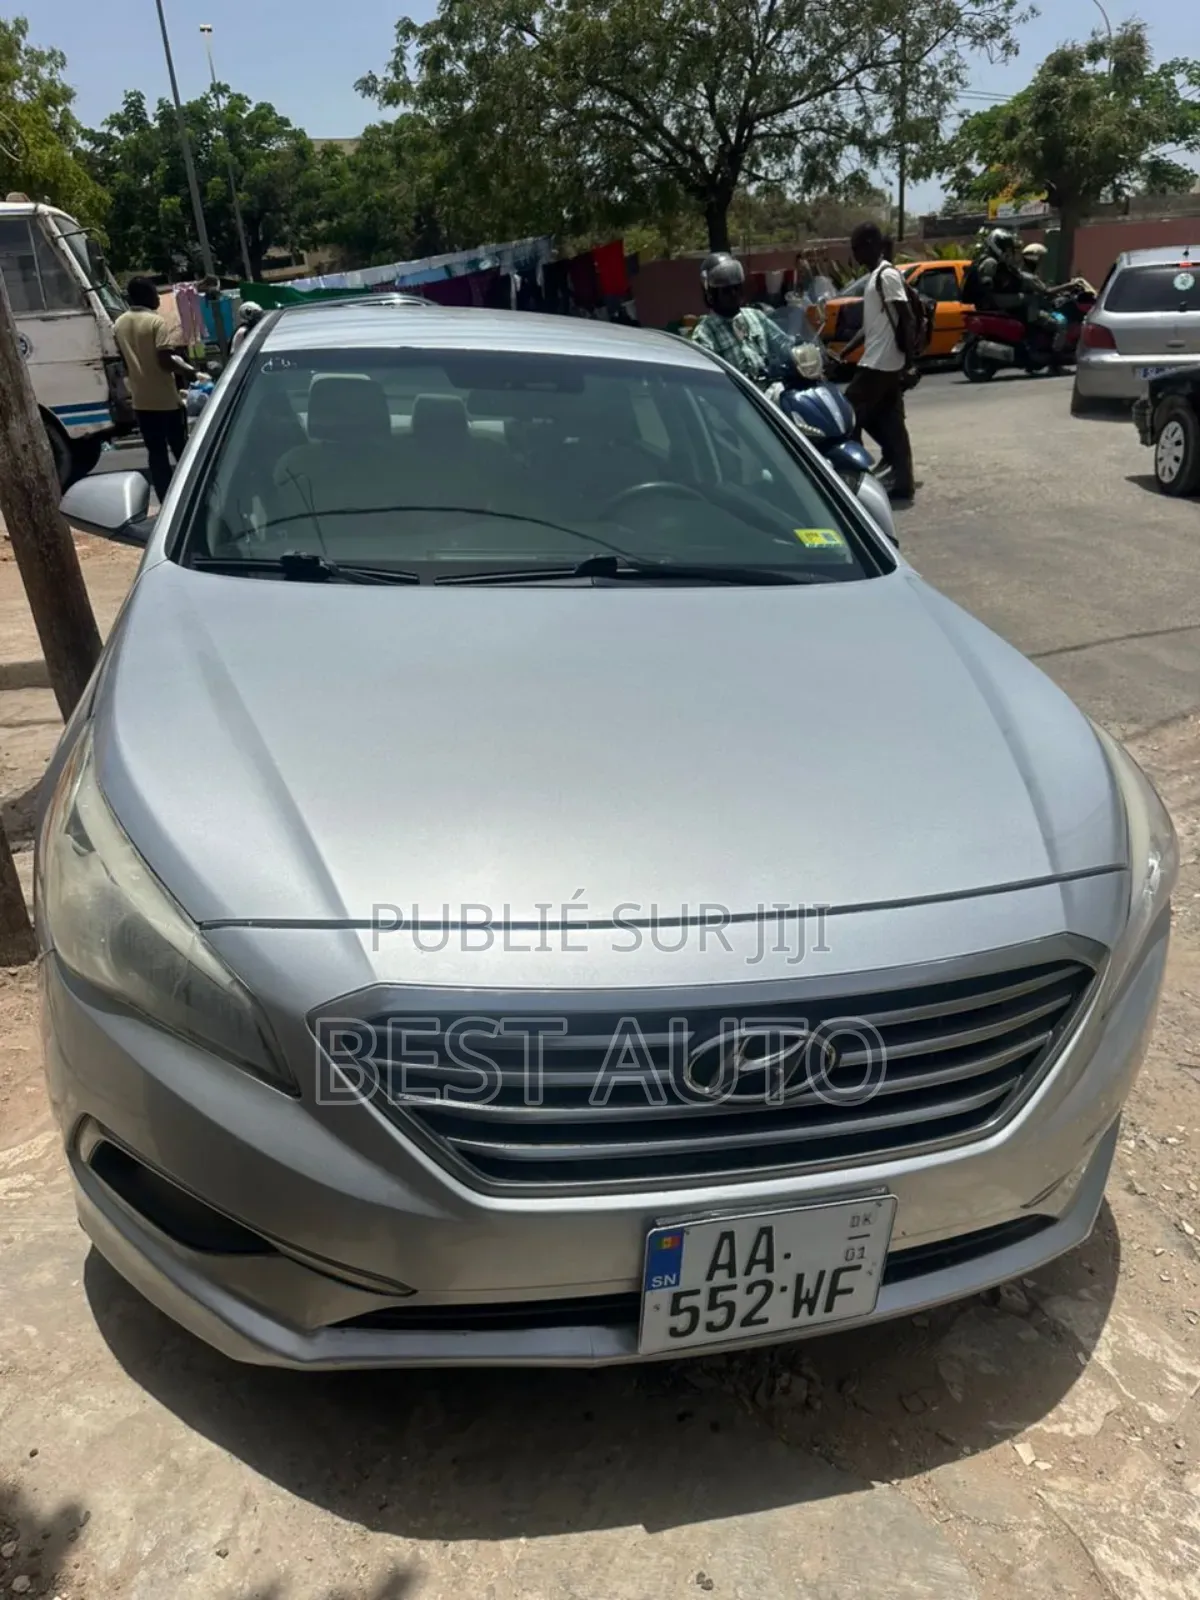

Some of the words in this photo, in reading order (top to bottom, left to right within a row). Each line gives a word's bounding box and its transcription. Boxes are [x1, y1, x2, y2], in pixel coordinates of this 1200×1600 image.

[850, 1212, 873, 1229] DK
[844, 1246, 866, 1262] 01
[651, 1273, 677, 1289] SN
